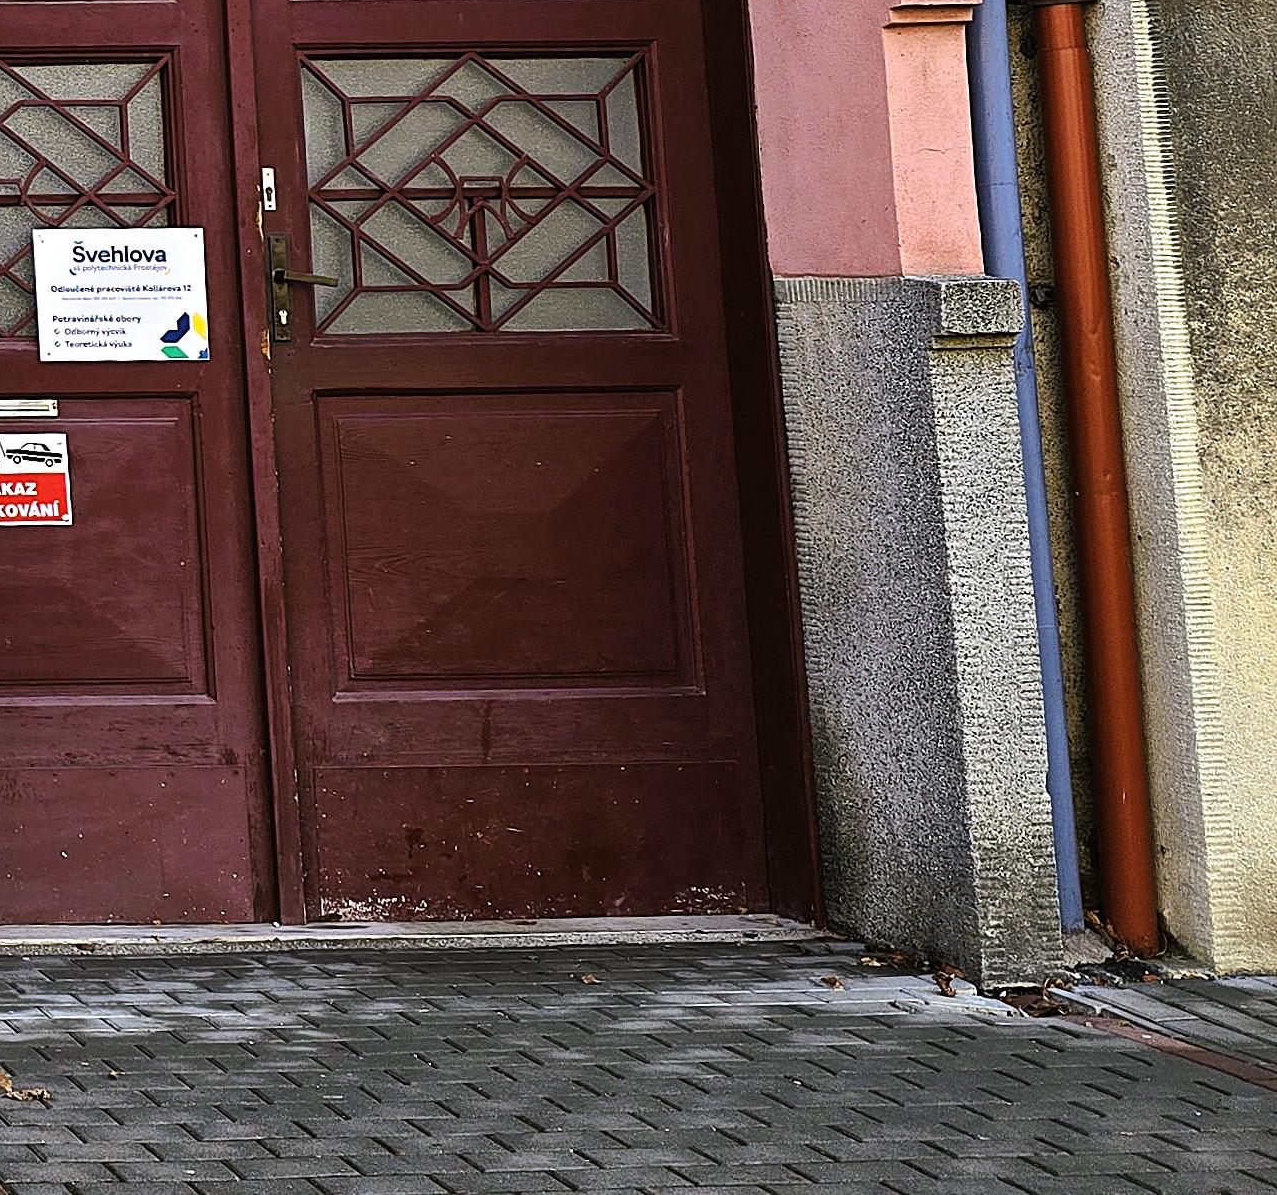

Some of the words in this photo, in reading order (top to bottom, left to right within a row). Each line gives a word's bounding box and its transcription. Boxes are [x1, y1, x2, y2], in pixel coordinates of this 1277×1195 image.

[72, 241, 167, 263] Švehlova
[50, 285, 94, 293] Odloučené
[96, 285, 141, 294] pracoviště
[183, 284, 192, 292] 12
[52, 315, 114, 323] Potravinářské
[115, 315, 141, 324] obory
[64, 328, 100, 337] Odborný
[65, 340, 107, 348] Teoretická
